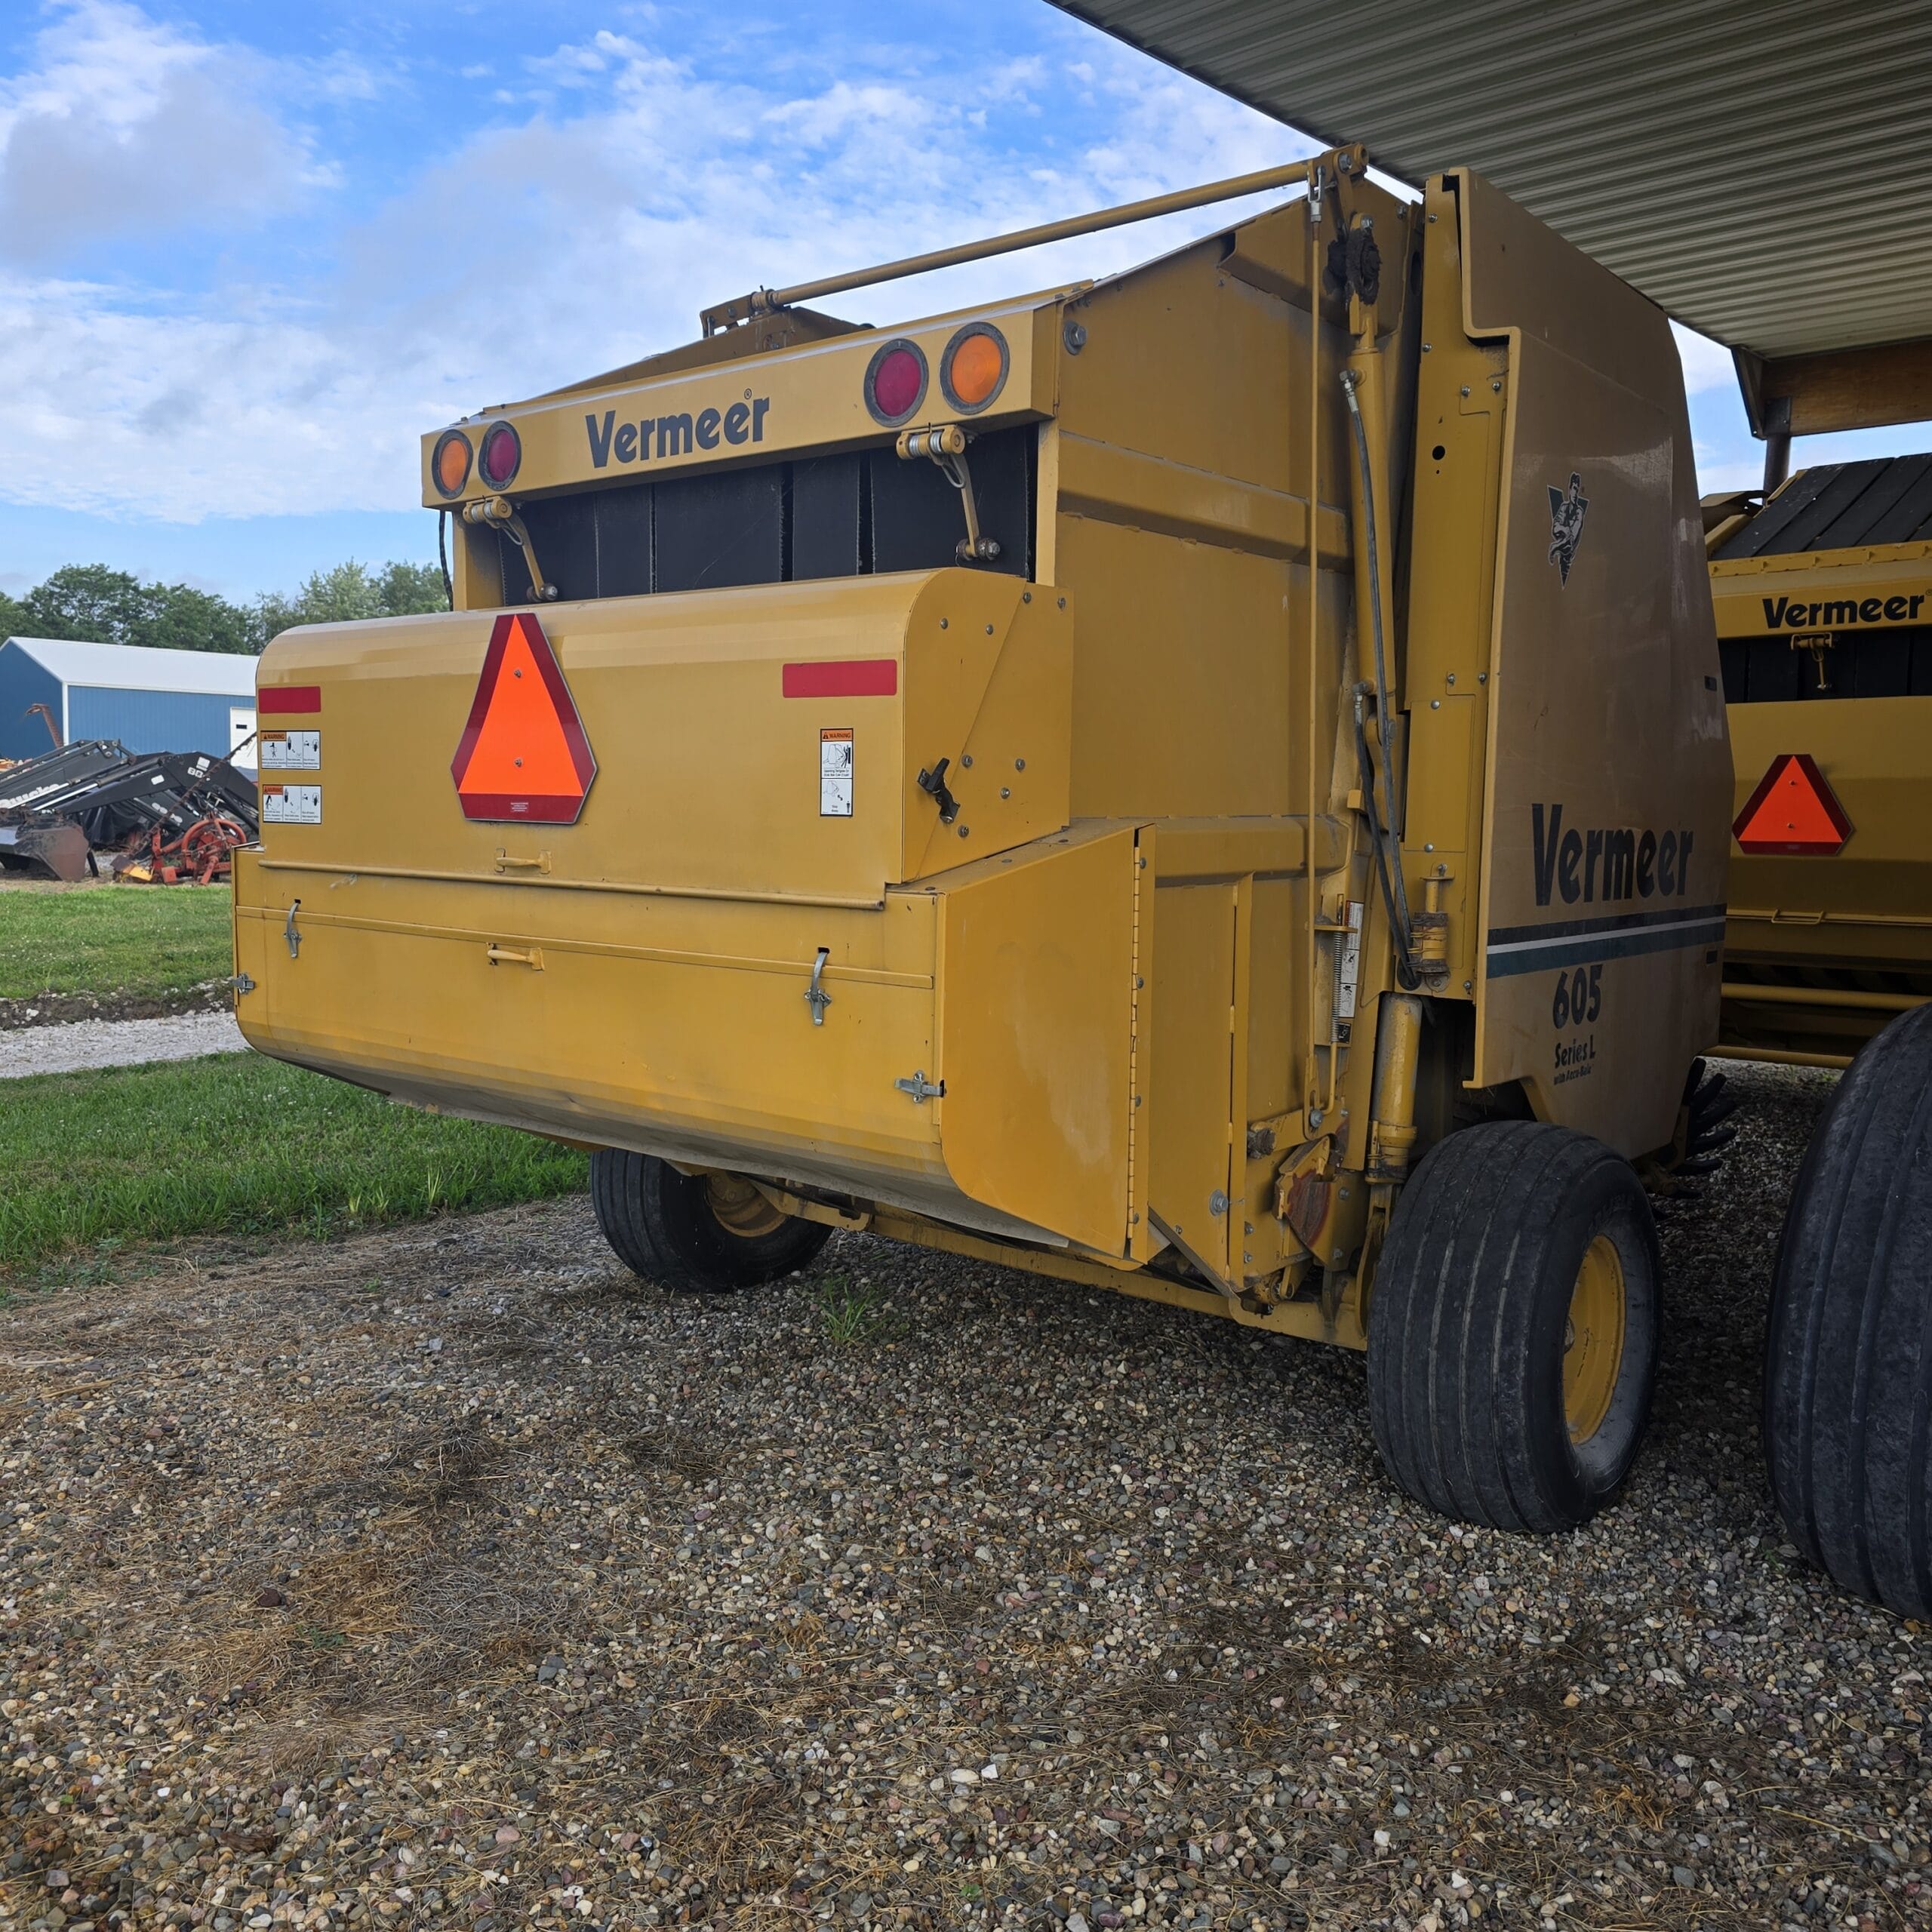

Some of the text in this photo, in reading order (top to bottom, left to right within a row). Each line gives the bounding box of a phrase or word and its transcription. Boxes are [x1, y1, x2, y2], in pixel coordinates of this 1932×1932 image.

[585, 396, 769, 469] Vermeer
[1762, 595, 1924, 629] Vermeer
[1531, 803, 1694, 906] Vermeer
[1552, 964, 1604, 1029] 605
[1555, 1034, 1596, 1069] Series L
